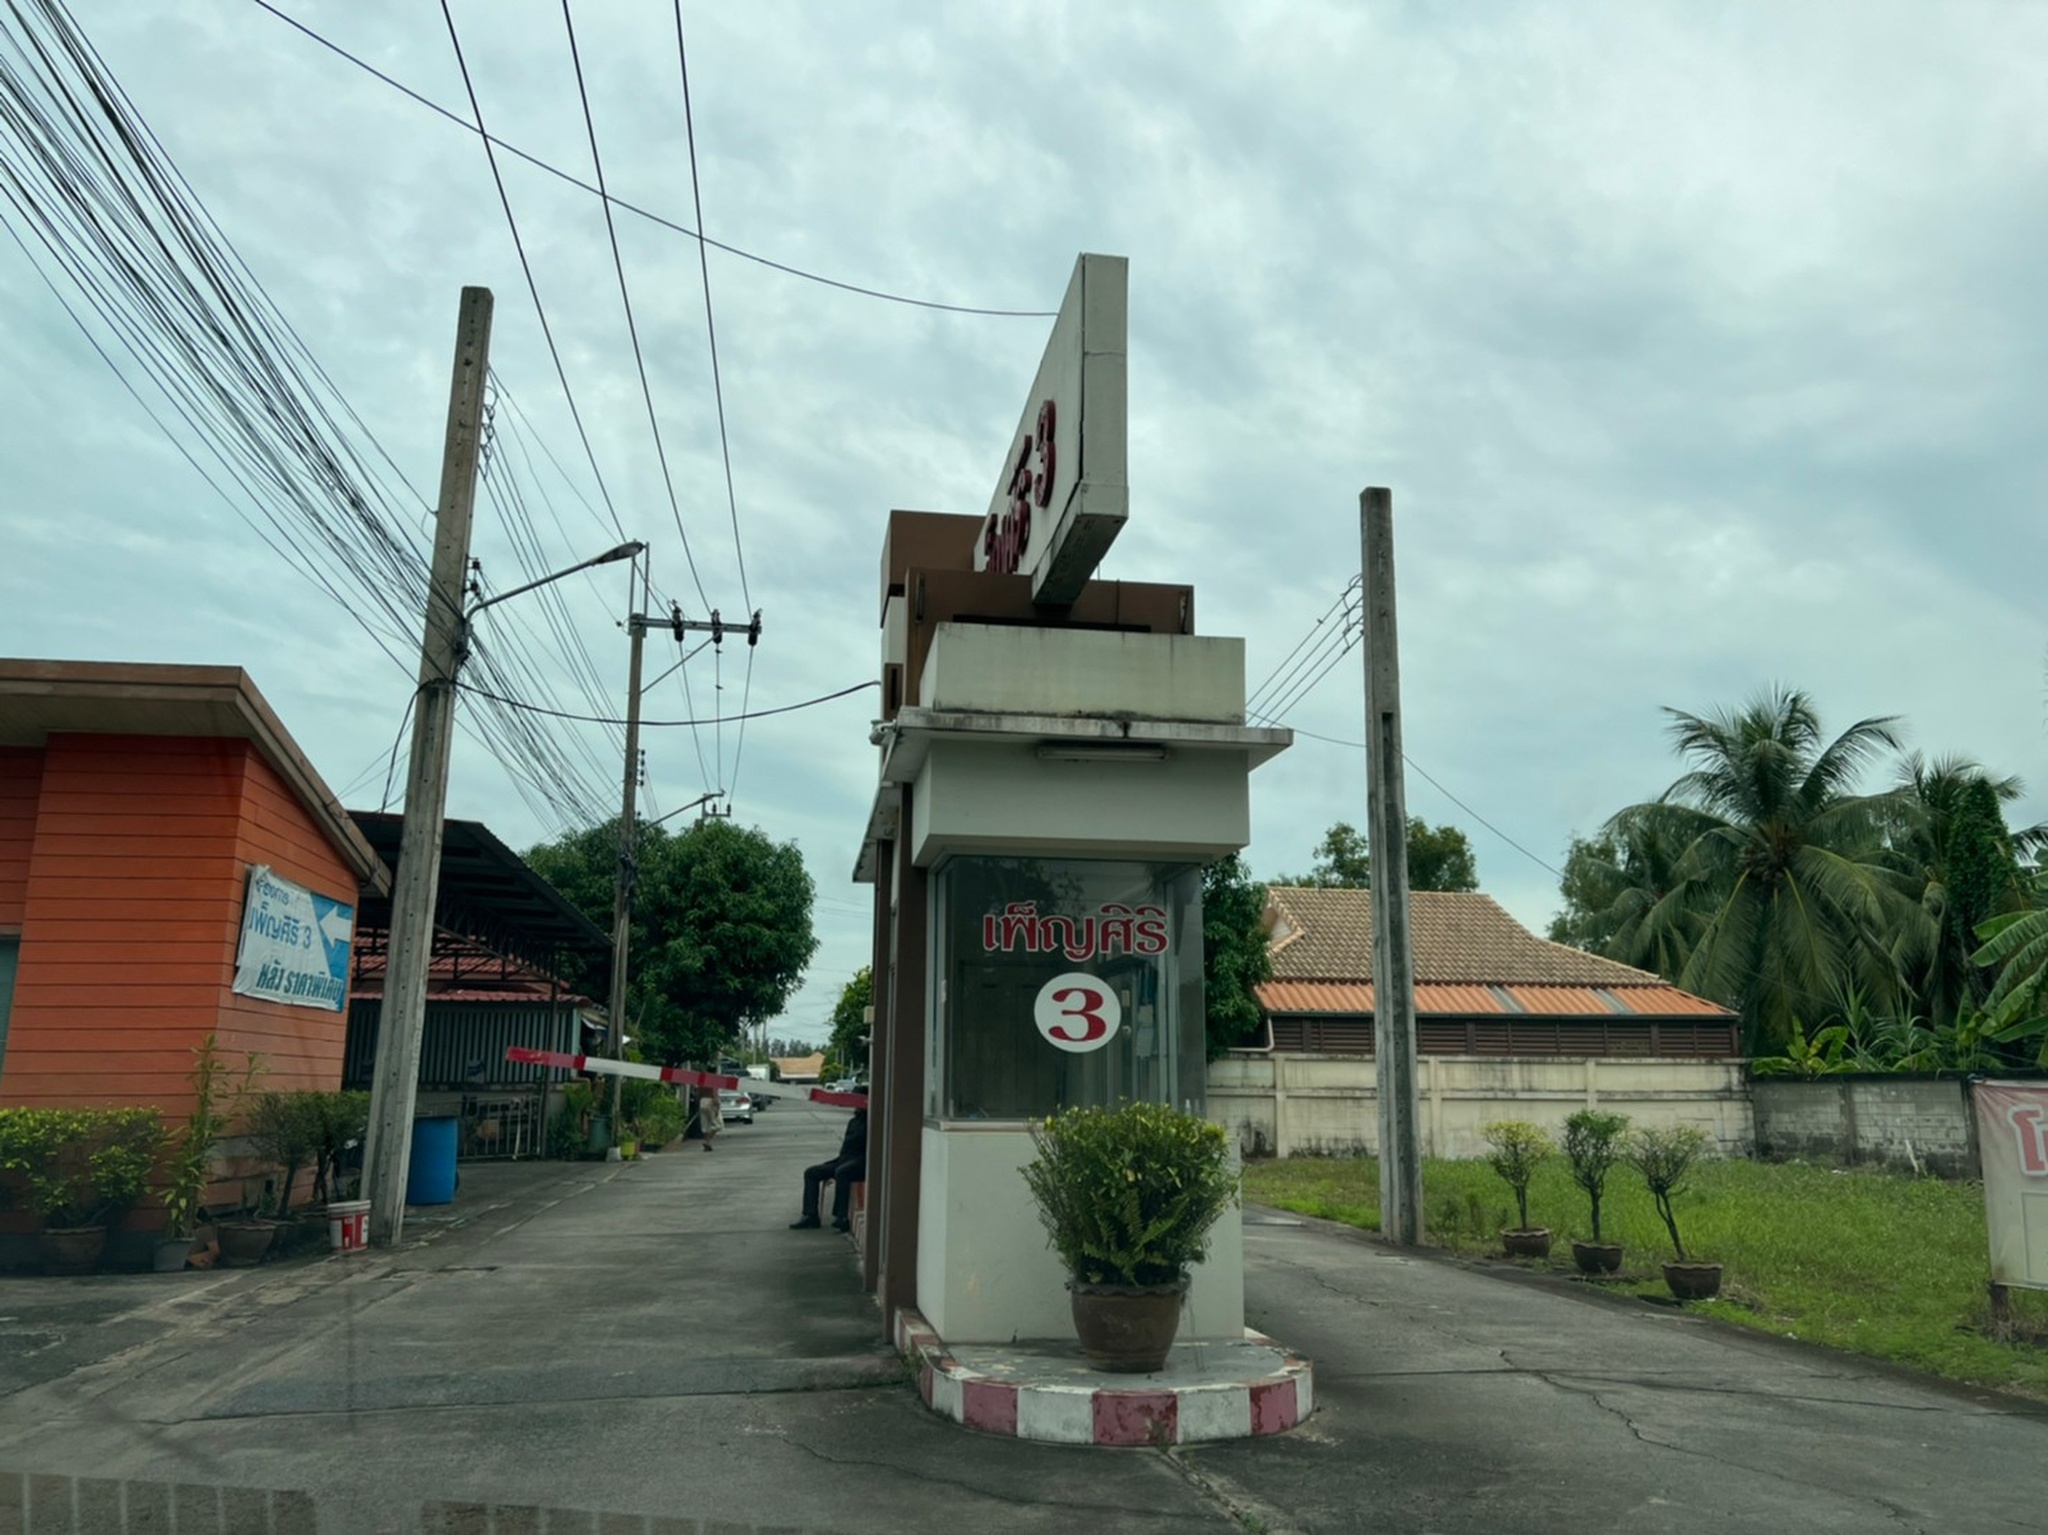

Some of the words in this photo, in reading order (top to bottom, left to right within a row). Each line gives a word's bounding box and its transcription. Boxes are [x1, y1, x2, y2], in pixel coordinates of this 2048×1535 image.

[303, 926, 312, 949] 3
[983, 900, 1169, 962] เพ็ญศิริ
[1048, 987, 1107, 1042] 3
